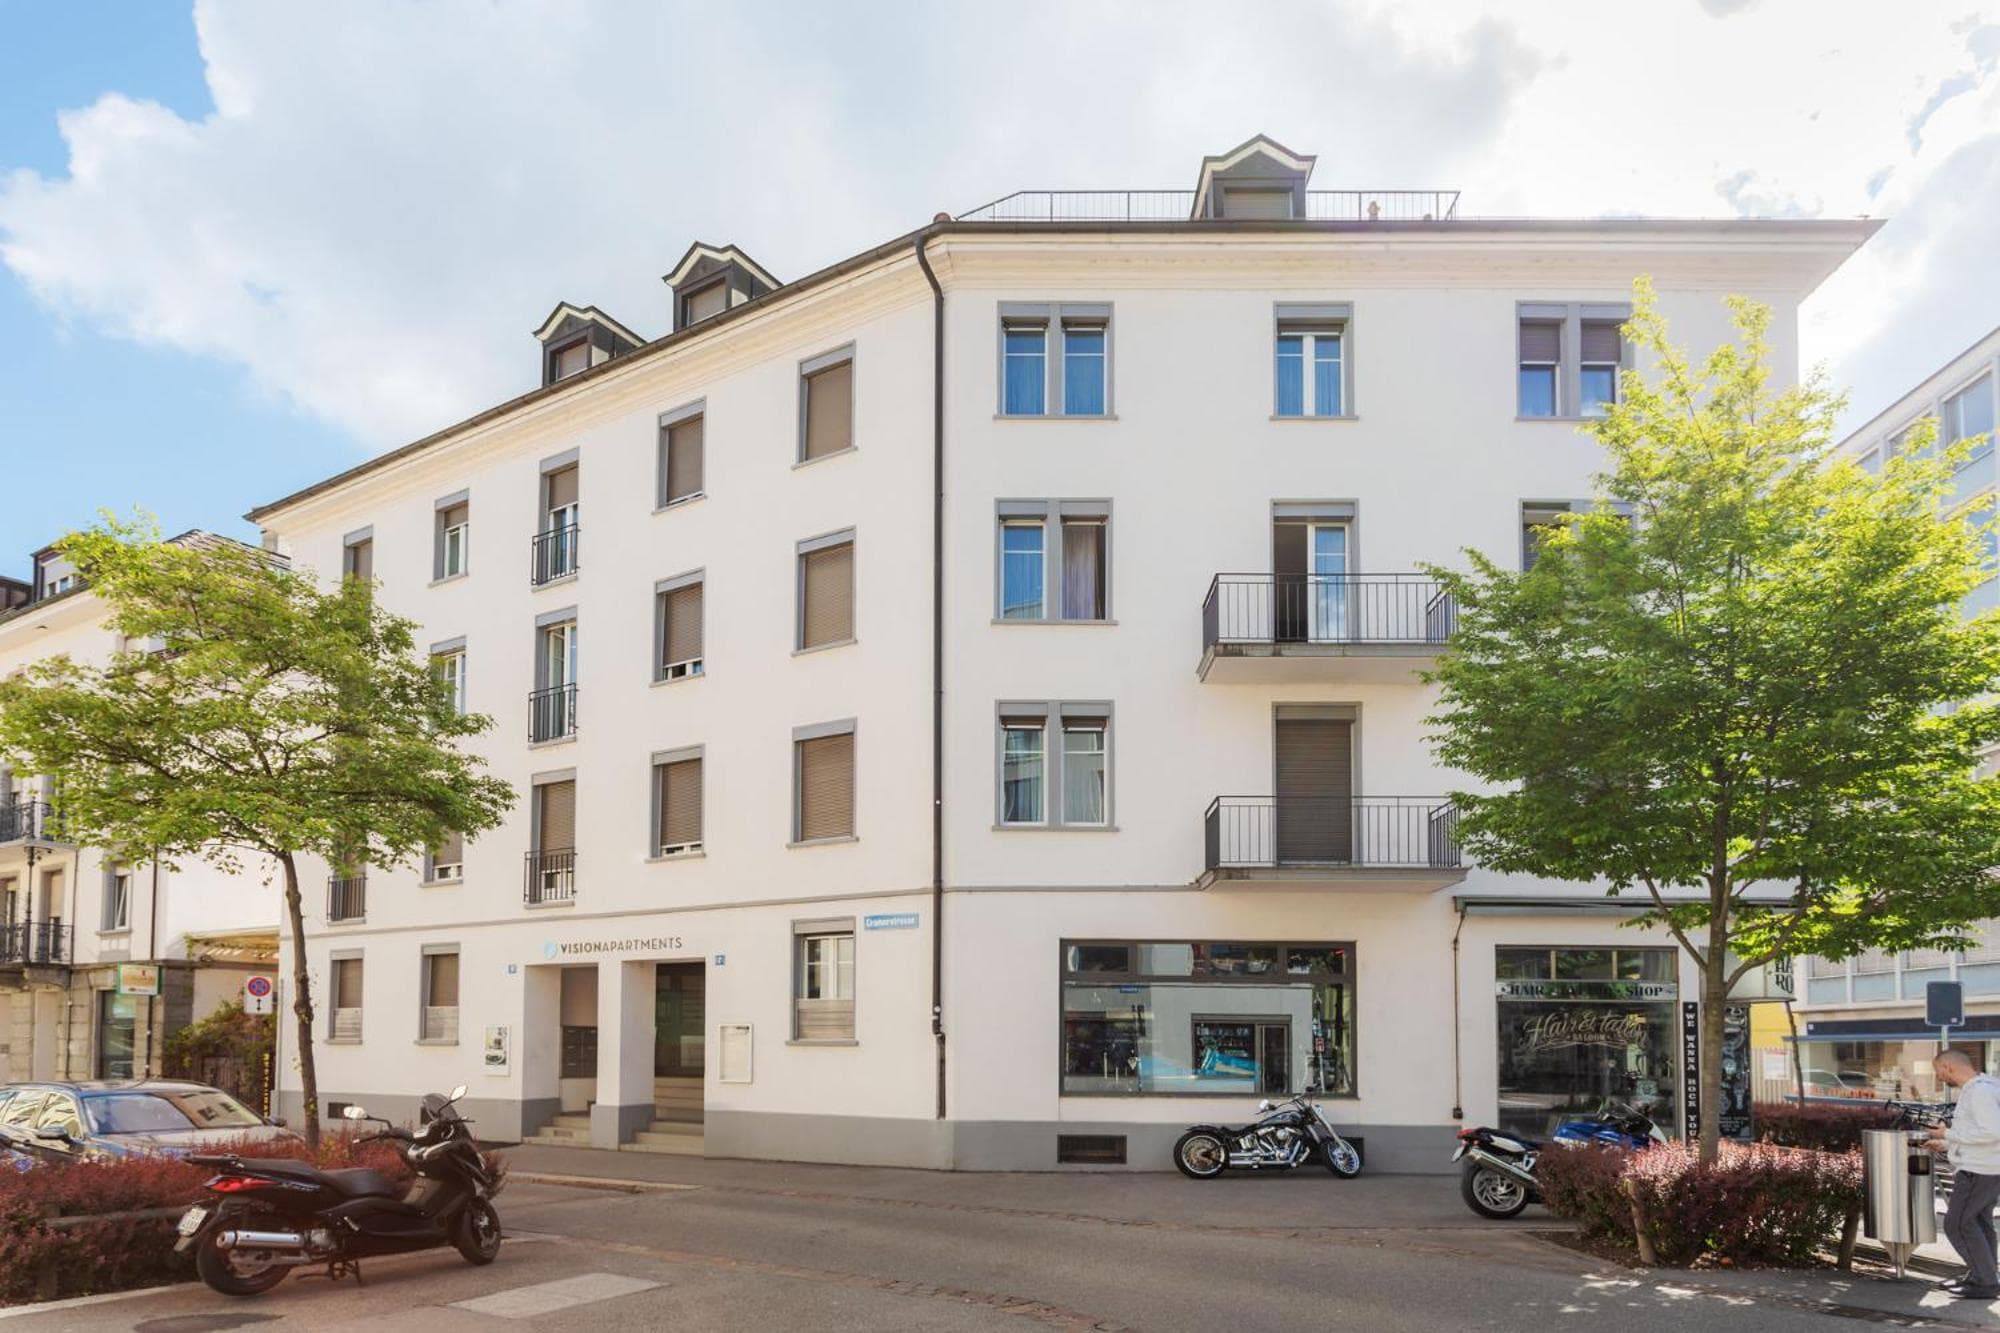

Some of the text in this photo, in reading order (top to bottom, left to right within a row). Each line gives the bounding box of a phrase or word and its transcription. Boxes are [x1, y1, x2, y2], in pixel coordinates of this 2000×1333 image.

[560, 937, 683, 954] VISIONAPARTMENTS
[1510, 985, 1545, 996] HAIR
[1627, 986, 1664, 997] SHOP
[1519, 1011, 1576, 1046] Hair
[1685, 1013, 1697, 1137] WE WANNA ROCK YOU
